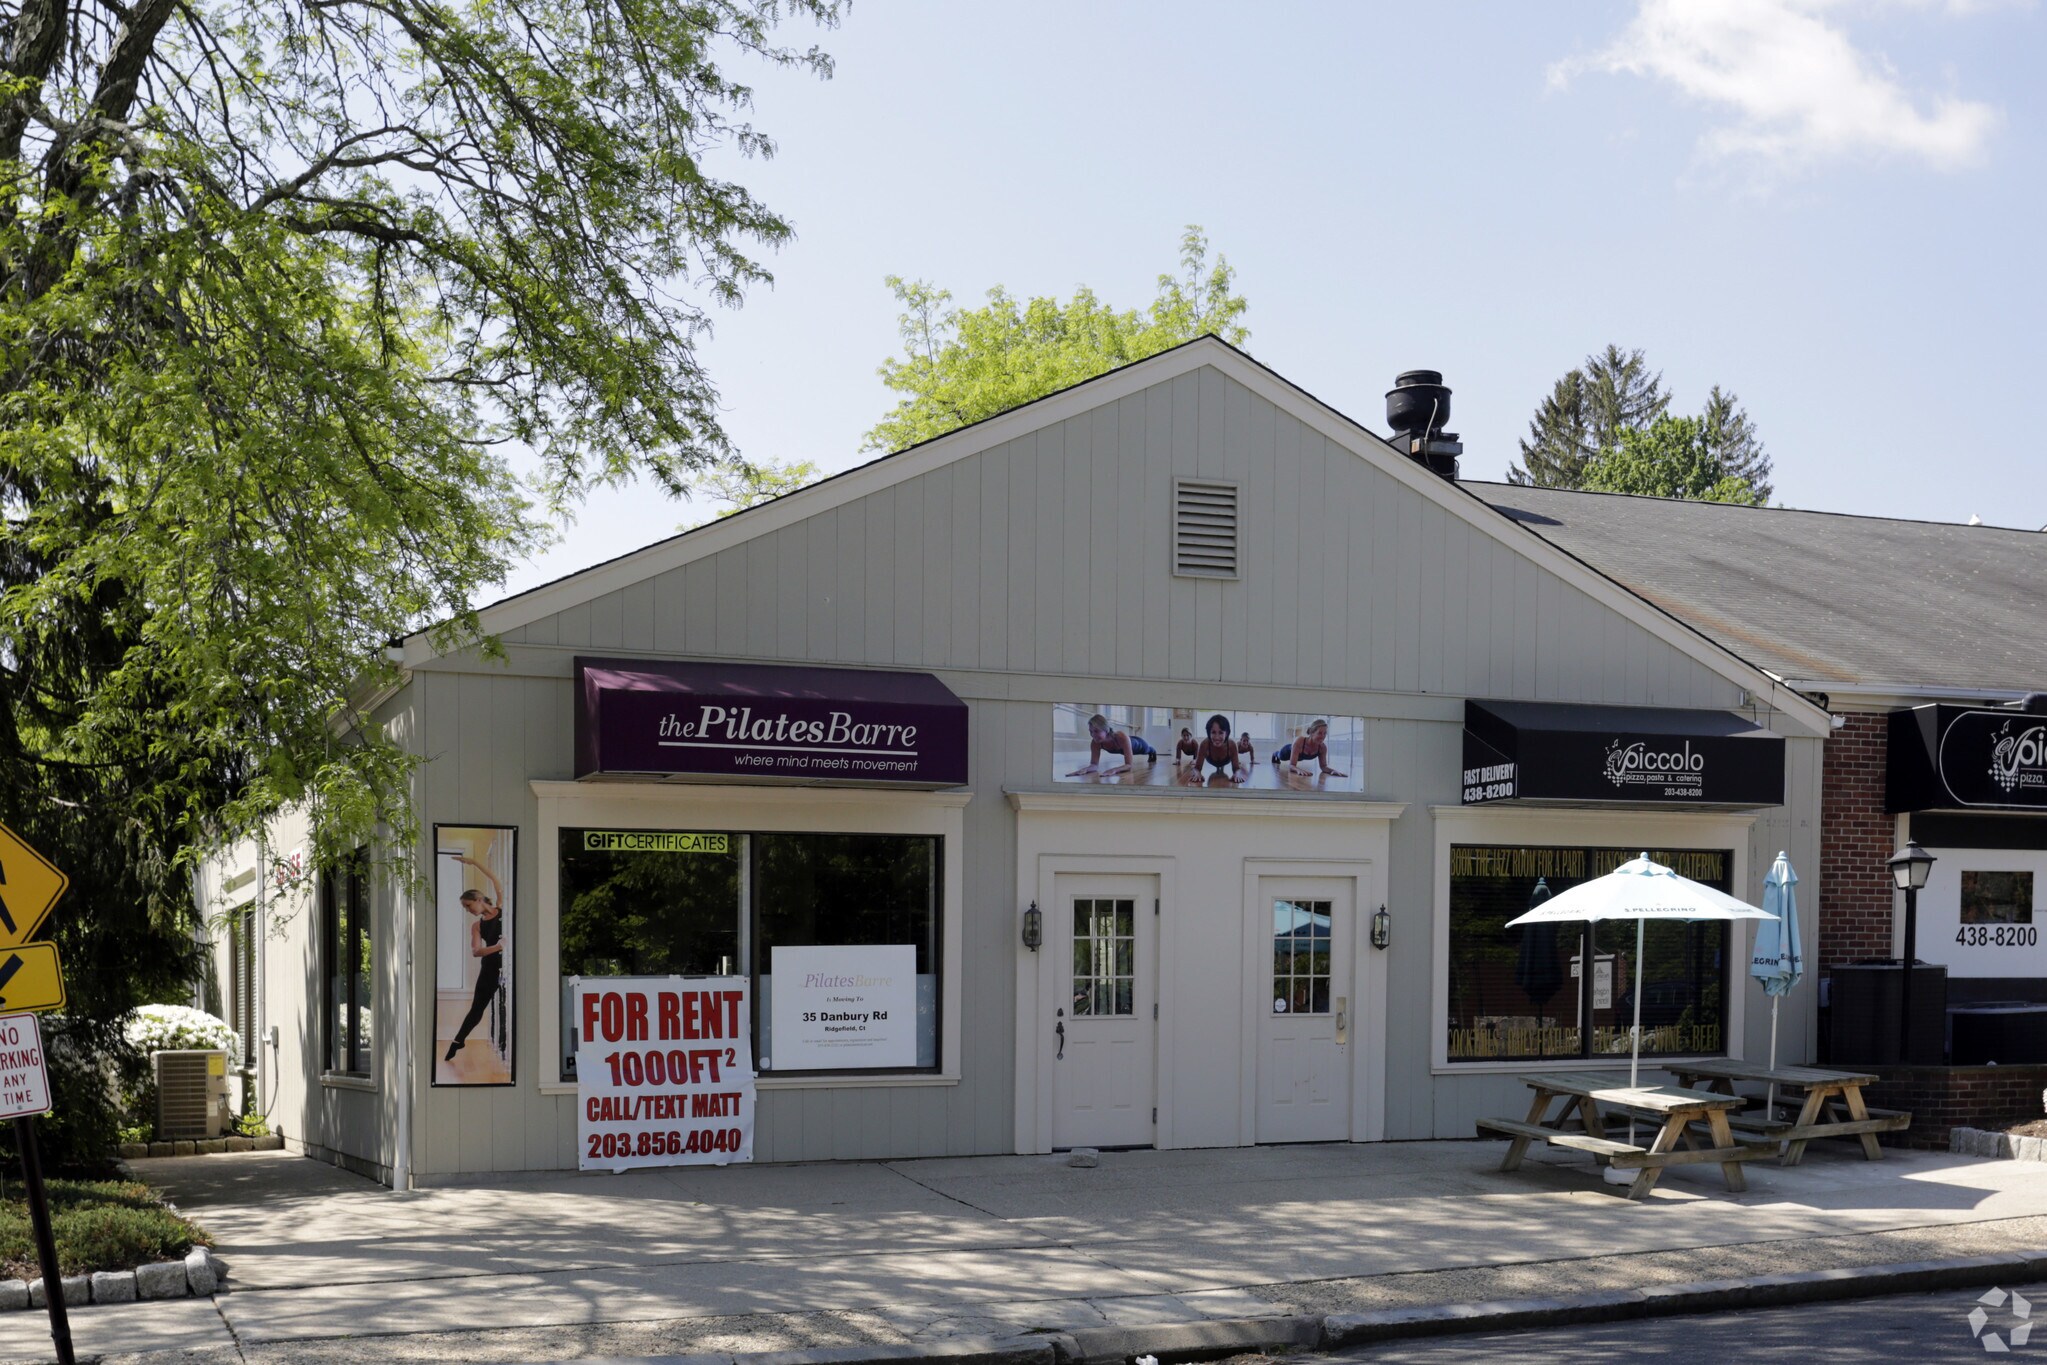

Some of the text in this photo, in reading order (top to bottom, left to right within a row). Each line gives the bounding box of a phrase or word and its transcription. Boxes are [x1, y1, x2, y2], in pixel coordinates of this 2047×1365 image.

[734, 754, 918, 772] where mind meets movement
[1609, 740, 1704, 776] piccolo
[1463, 763, 1514, 786] FAST DELIVERY
[1625, 773, 1703, 787] pizza, pasta & catering
[1463, 782, 1513, 801] 438-8200
[1664, 787, 1703, 797] 203-438-8200
[1450, 848, 1586, 878] BOOK THE JAZZ ROOM FOR A PARTY
[1680, 852, 1723, 881] CATERING
[1955, 926, 2037, 947] 438-8200
[582, 990, 743, 1043] FOR RENT
[802, 1011, 888, 1023] 35 Danbury Rd
[824, 1025, 858, 1033] Ridgefield,
[1692, 1025, 1720, 1052] BEER
[0, 1048, 39, 1071] RKING
[4, 1073, 26, 1089] ANY
[3, 1089, 33, 1106] TIME
[586, 1092, 742, 1123] CALL/TEXT MATT
[587, 1128, 742, 1159] 203.856.4040
